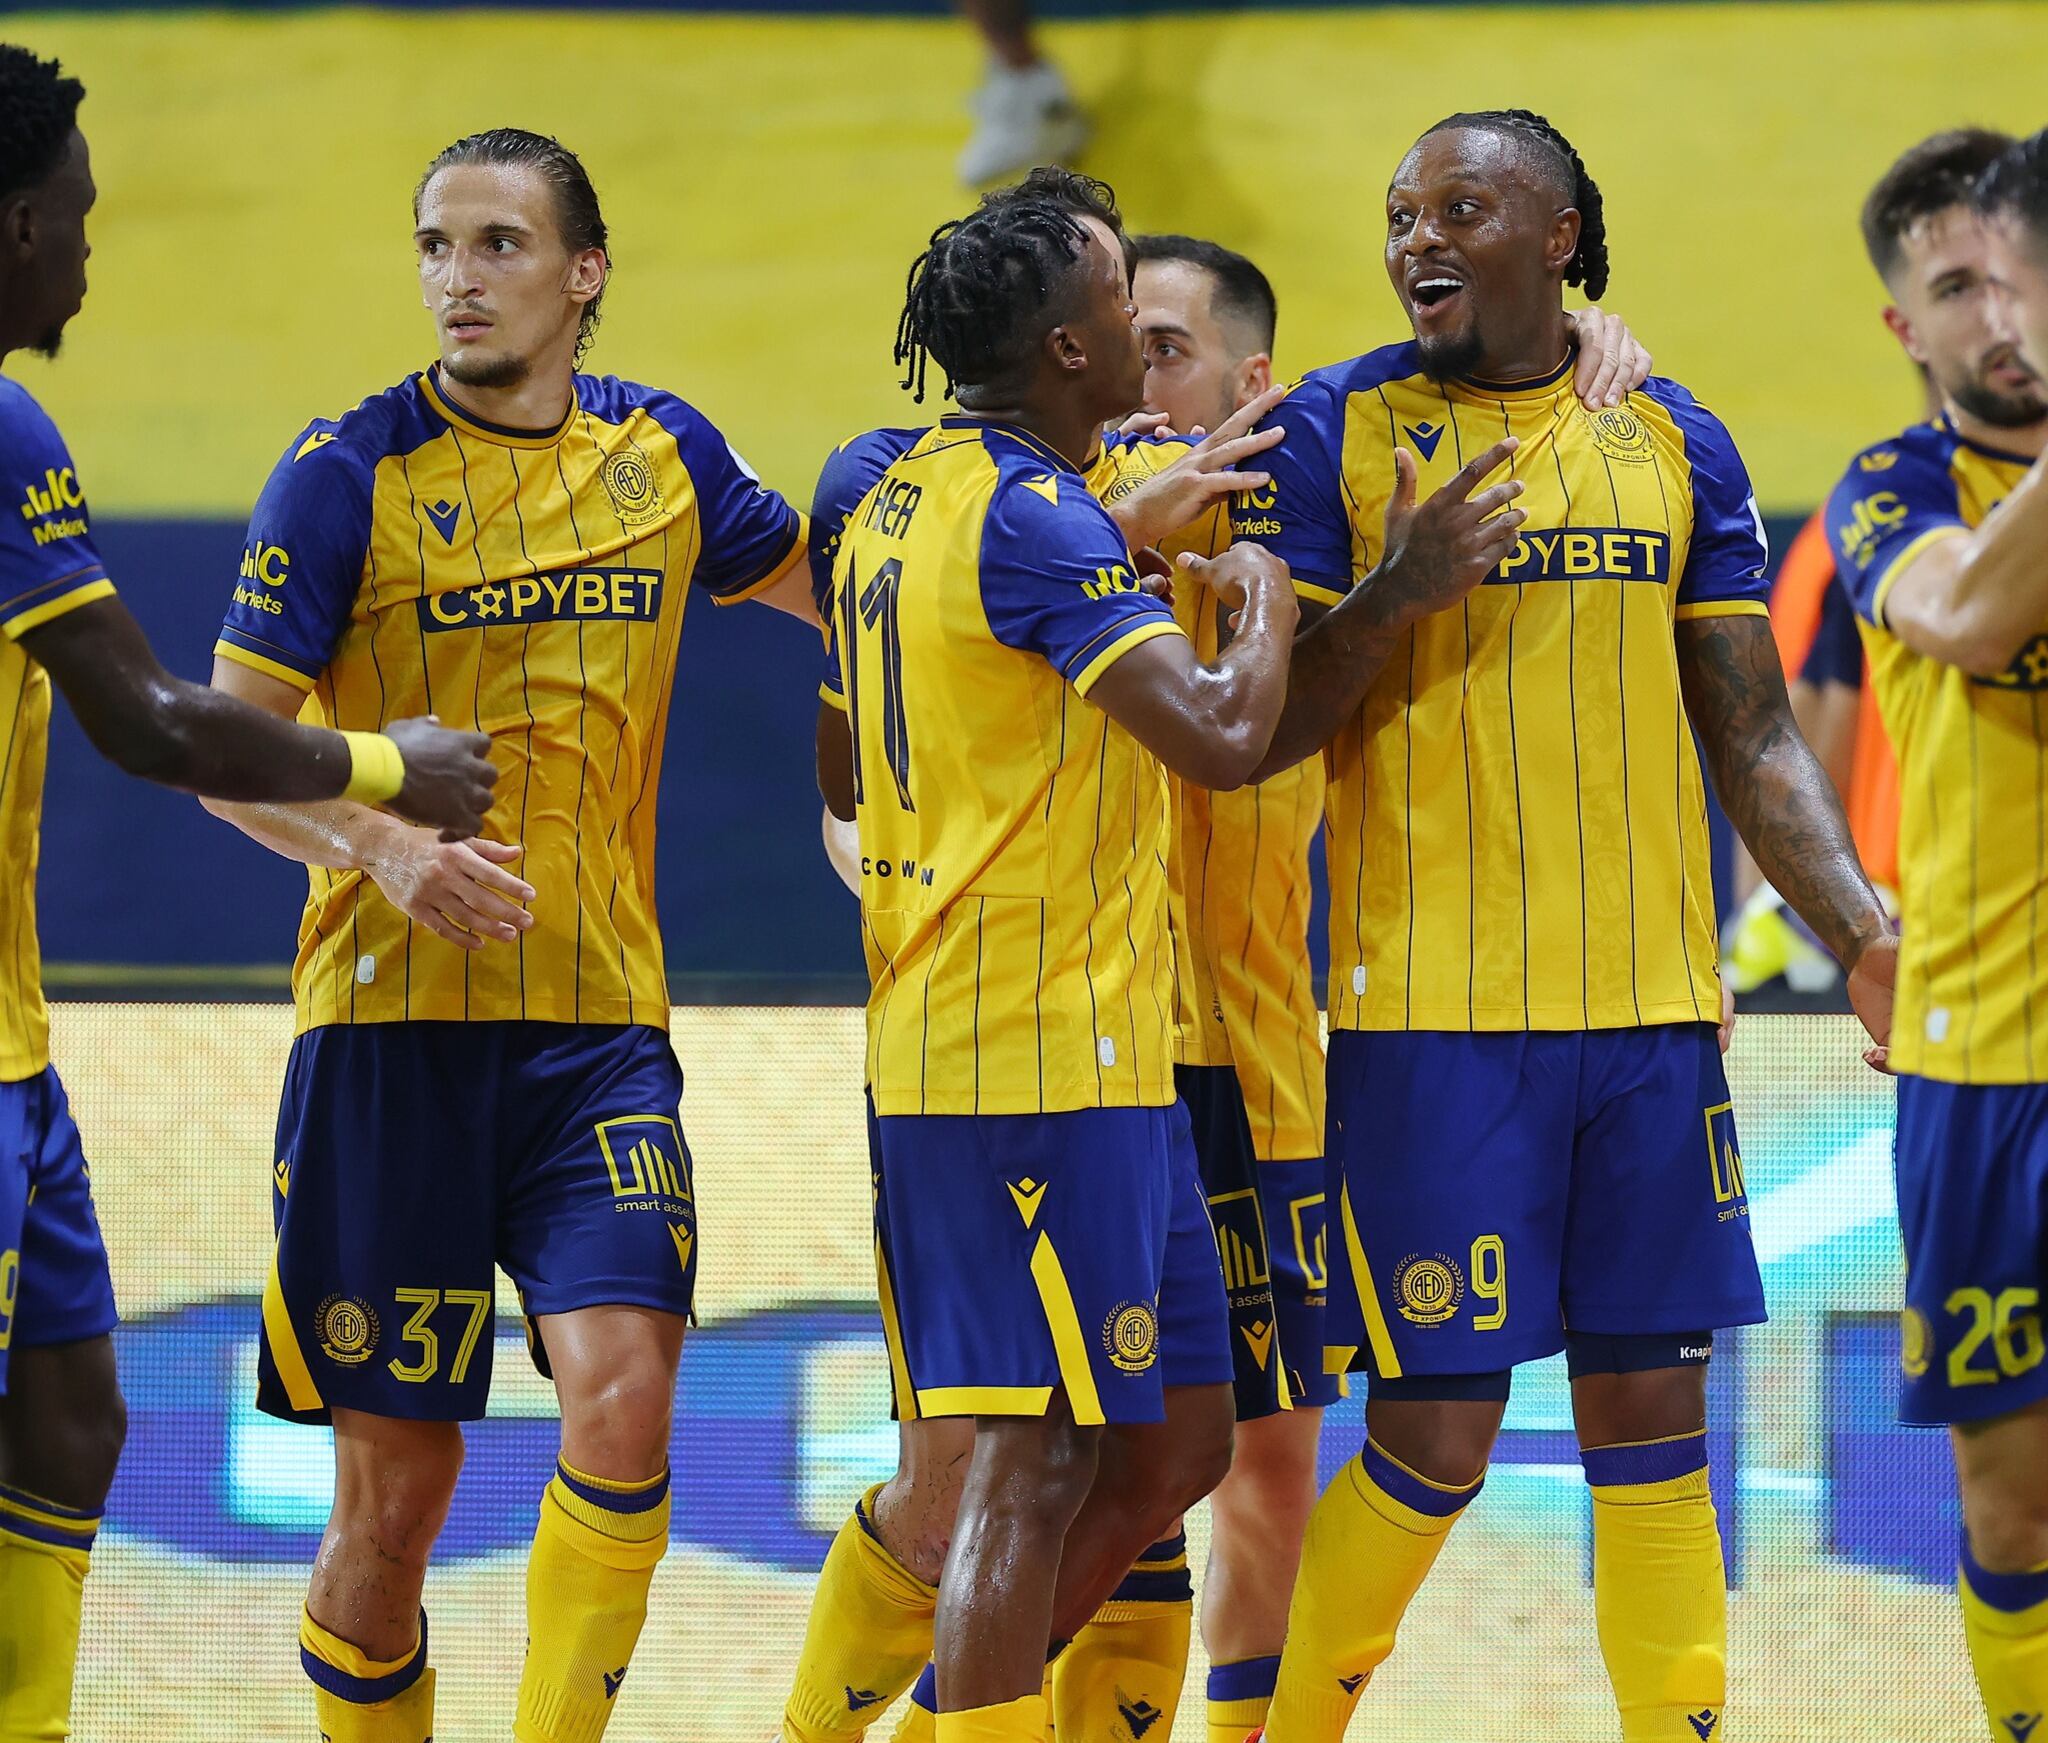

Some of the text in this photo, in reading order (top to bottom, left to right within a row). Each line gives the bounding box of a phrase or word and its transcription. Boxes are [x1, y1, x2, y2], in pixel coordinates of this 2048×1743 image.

[1499, 533, 1663, 578] PYBET
[838, 545, 917, 814] 11
[615, 1199, 661, 1213] smart
[1470, 1233, 1508, 1331] 9
[387, 1287, 491, 1383] 37
[1943, 1286, 2046, 1389] 26
